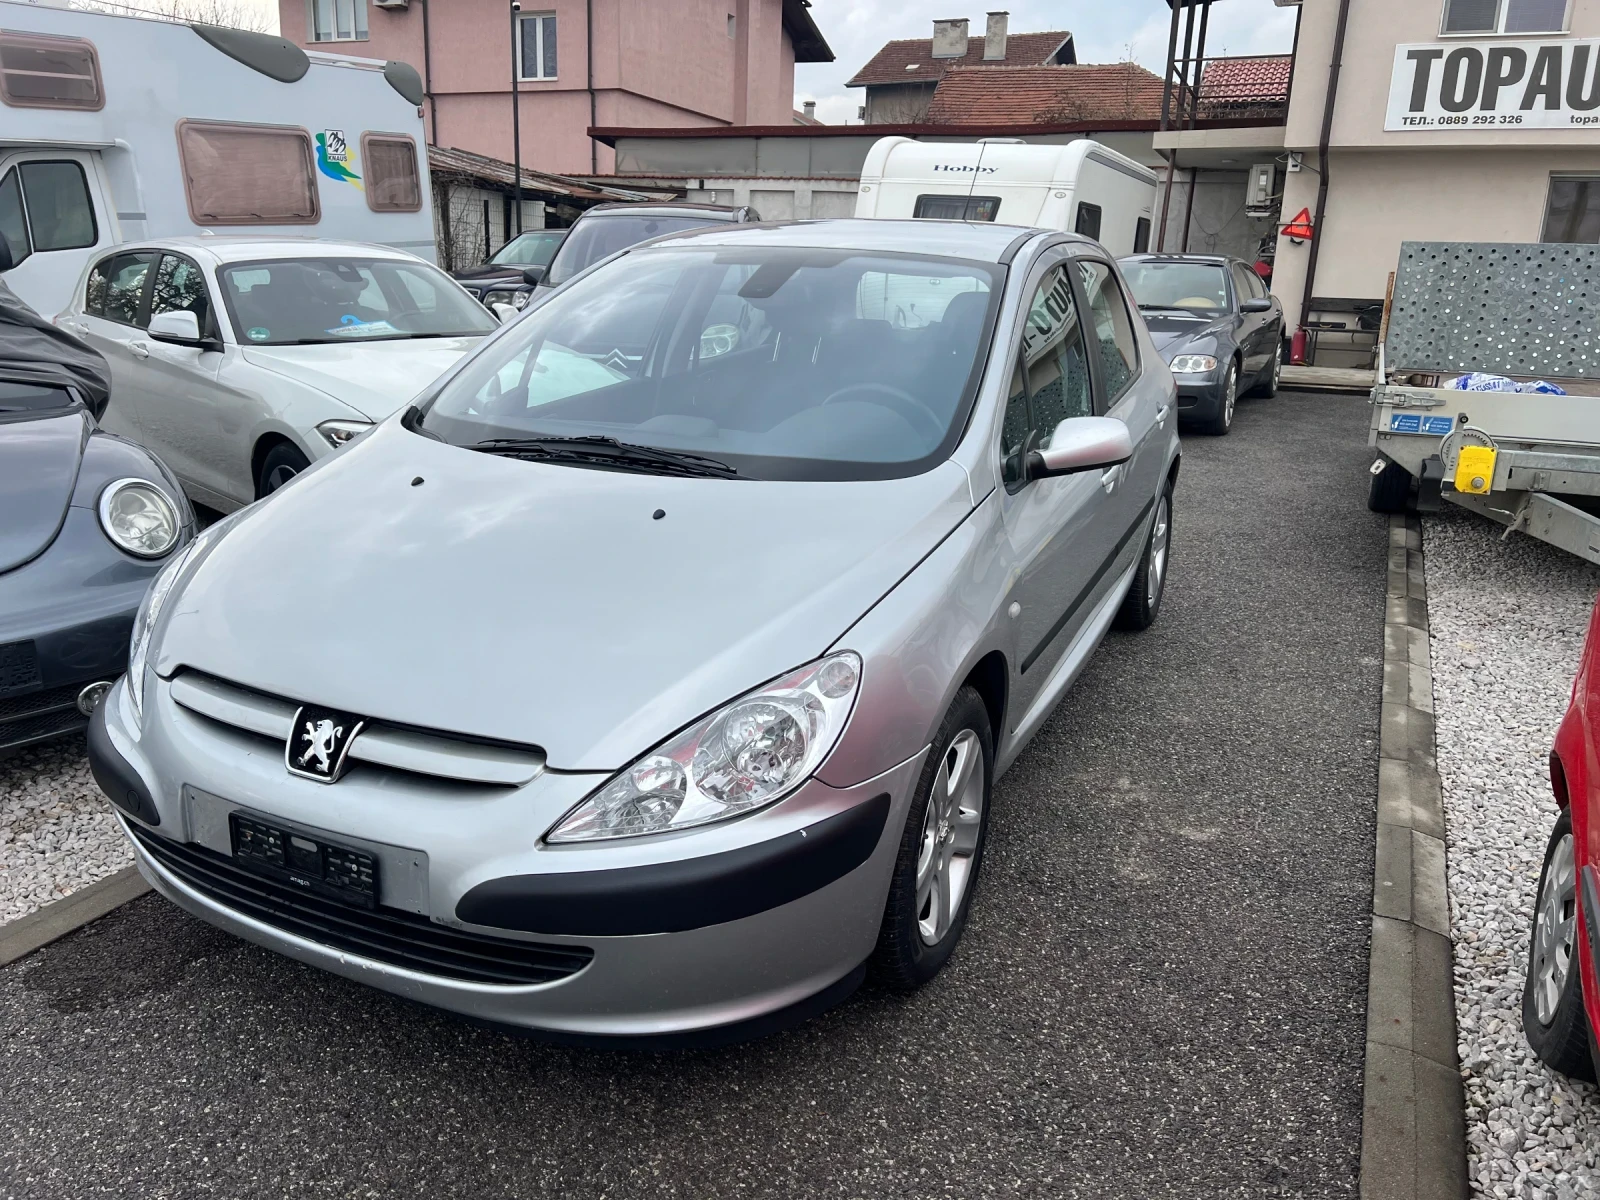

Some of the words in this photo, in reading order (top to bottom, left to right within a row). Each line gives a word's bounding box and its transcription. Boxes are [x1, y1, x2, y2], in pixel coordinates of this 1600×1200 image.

[1406, 45, 1600, 112] TOPAU
[1402, 117, 1434, 125] ТЕЛ.:
[1438, 116, 1468, 125] 0889
[1472, 115, 1496, 124] 292
[1499, 115, 1523, 124] 326
[1570, 115, 1600, 125] topa
[933, 164, 999, 175] Hobby
